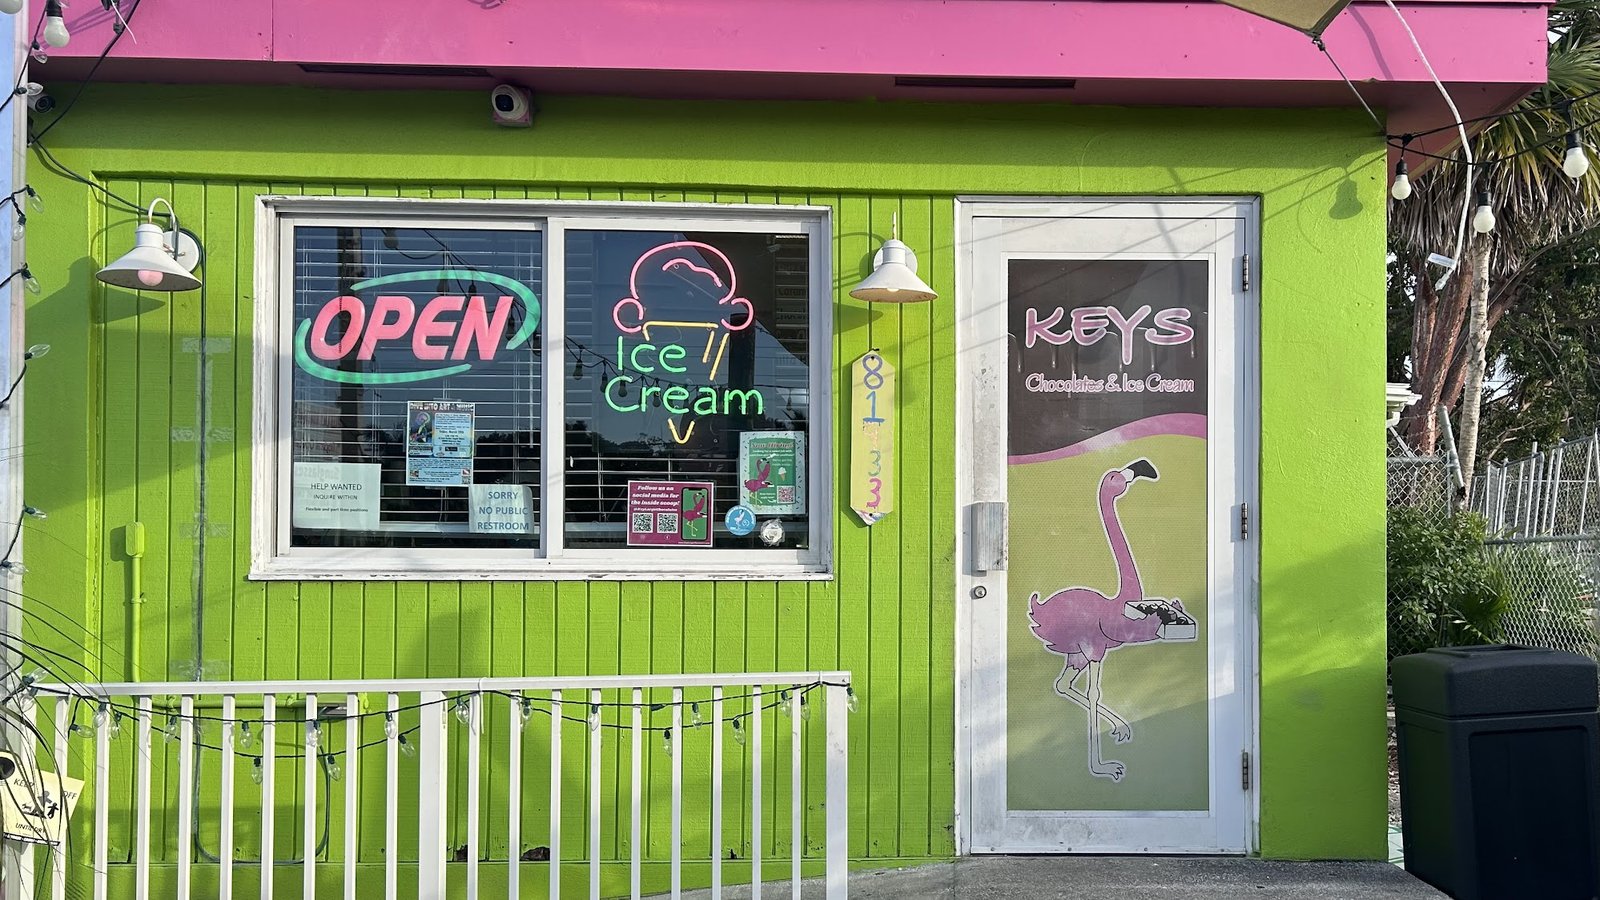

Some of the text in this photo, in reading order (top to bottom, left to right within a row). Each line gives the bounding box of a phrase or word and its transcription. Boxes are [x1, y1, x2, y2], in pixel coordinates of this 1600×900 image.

[310, 295, 514, 361] OPEN
[1025, 304, 1195, 365] KEYS
[617, 335, 687, 373] Ice
[1025, 372, 1195, 393] Chocolates & Ice Cream
[604, 375, 763, 415] Cream
[439, 403, 450, 411] ART
[330, 483, 362, 491] WANTED
[487, 490, 518, 500] SORRY
[478, 505, 528, 516] NO PUBLIC
[477, 521, 529, 531] RESTROOM
[14, 778, 78, 800] KEP OFF
